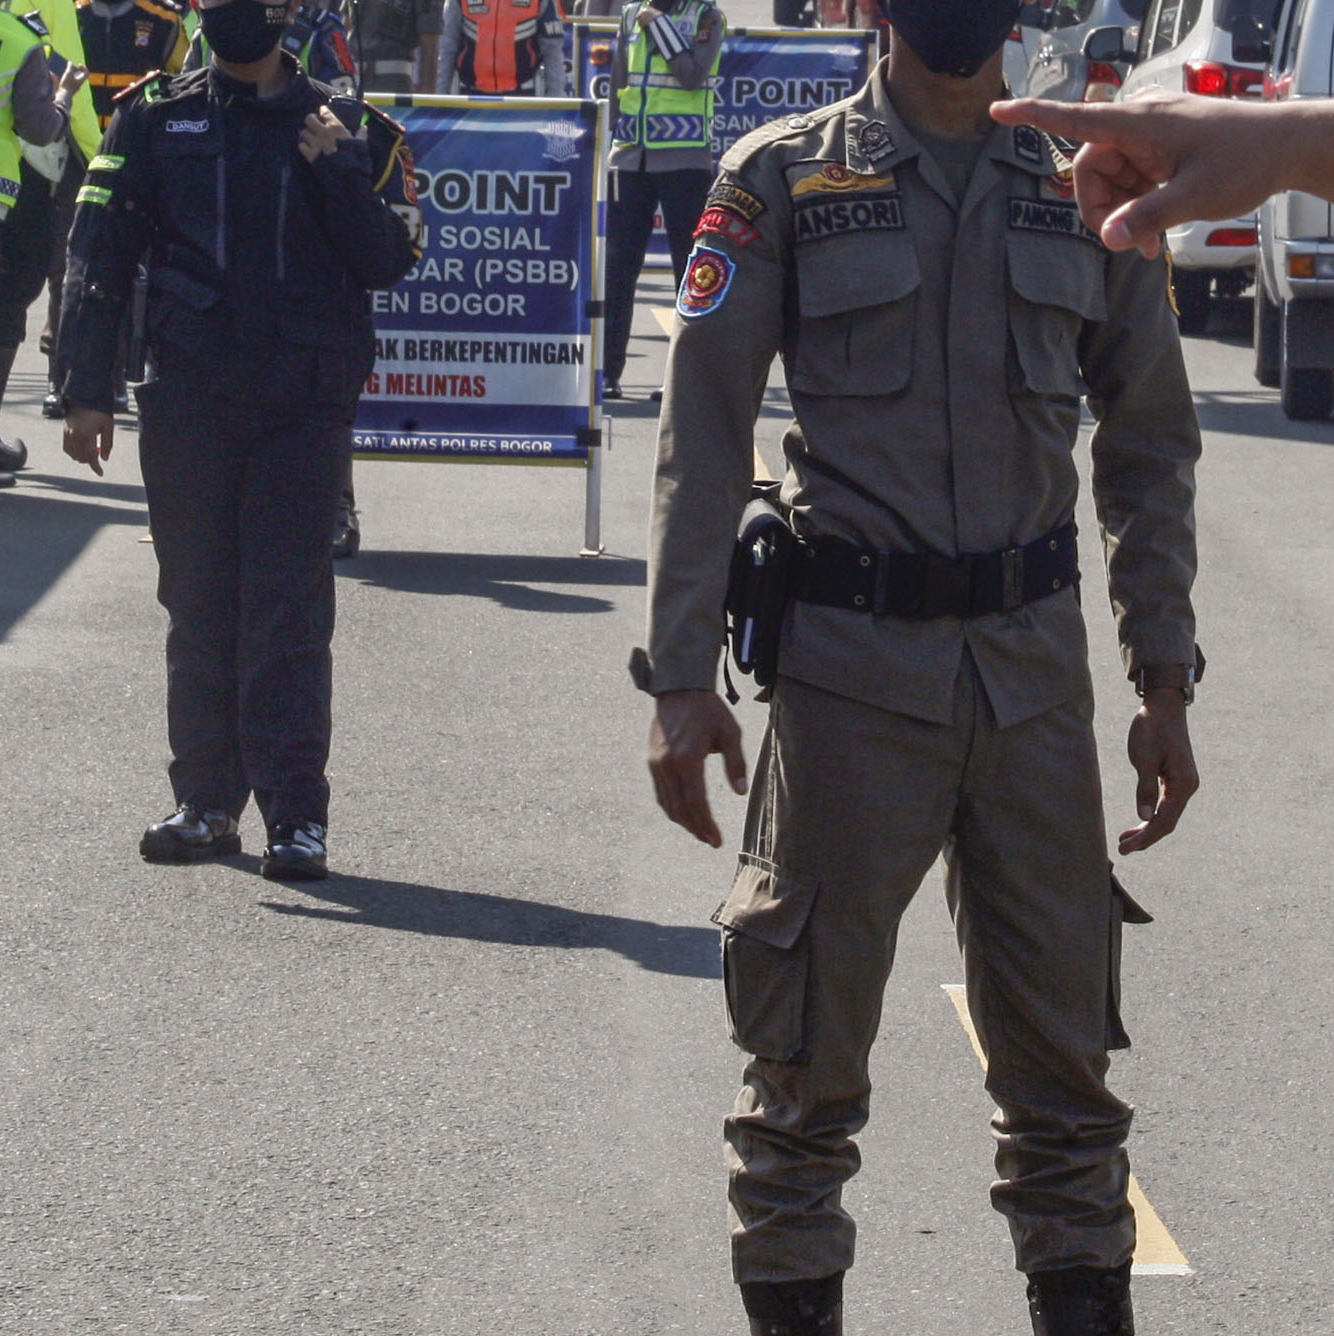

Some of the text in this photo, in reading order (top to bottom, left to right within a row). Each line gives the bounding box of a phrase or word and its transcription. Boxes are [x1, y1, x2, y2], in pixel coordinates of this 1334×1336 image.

[732, 77, 852, 108] POINT
[411, 168, 571, 215] POINT
[796, 198, 900, 239] ANSORI
[439, 224, 551, 251] SOSIAL
[474, 259, 579, 291] (PSBB)
[419, 292, 527, 317] BOGOR
[403, 339, 585, 366] BERKEPENTINGAN
[385, 372, 487, 399] MELINTAS
[353, 435, 553, 454] SATLANTAS POLRES BOGOR
